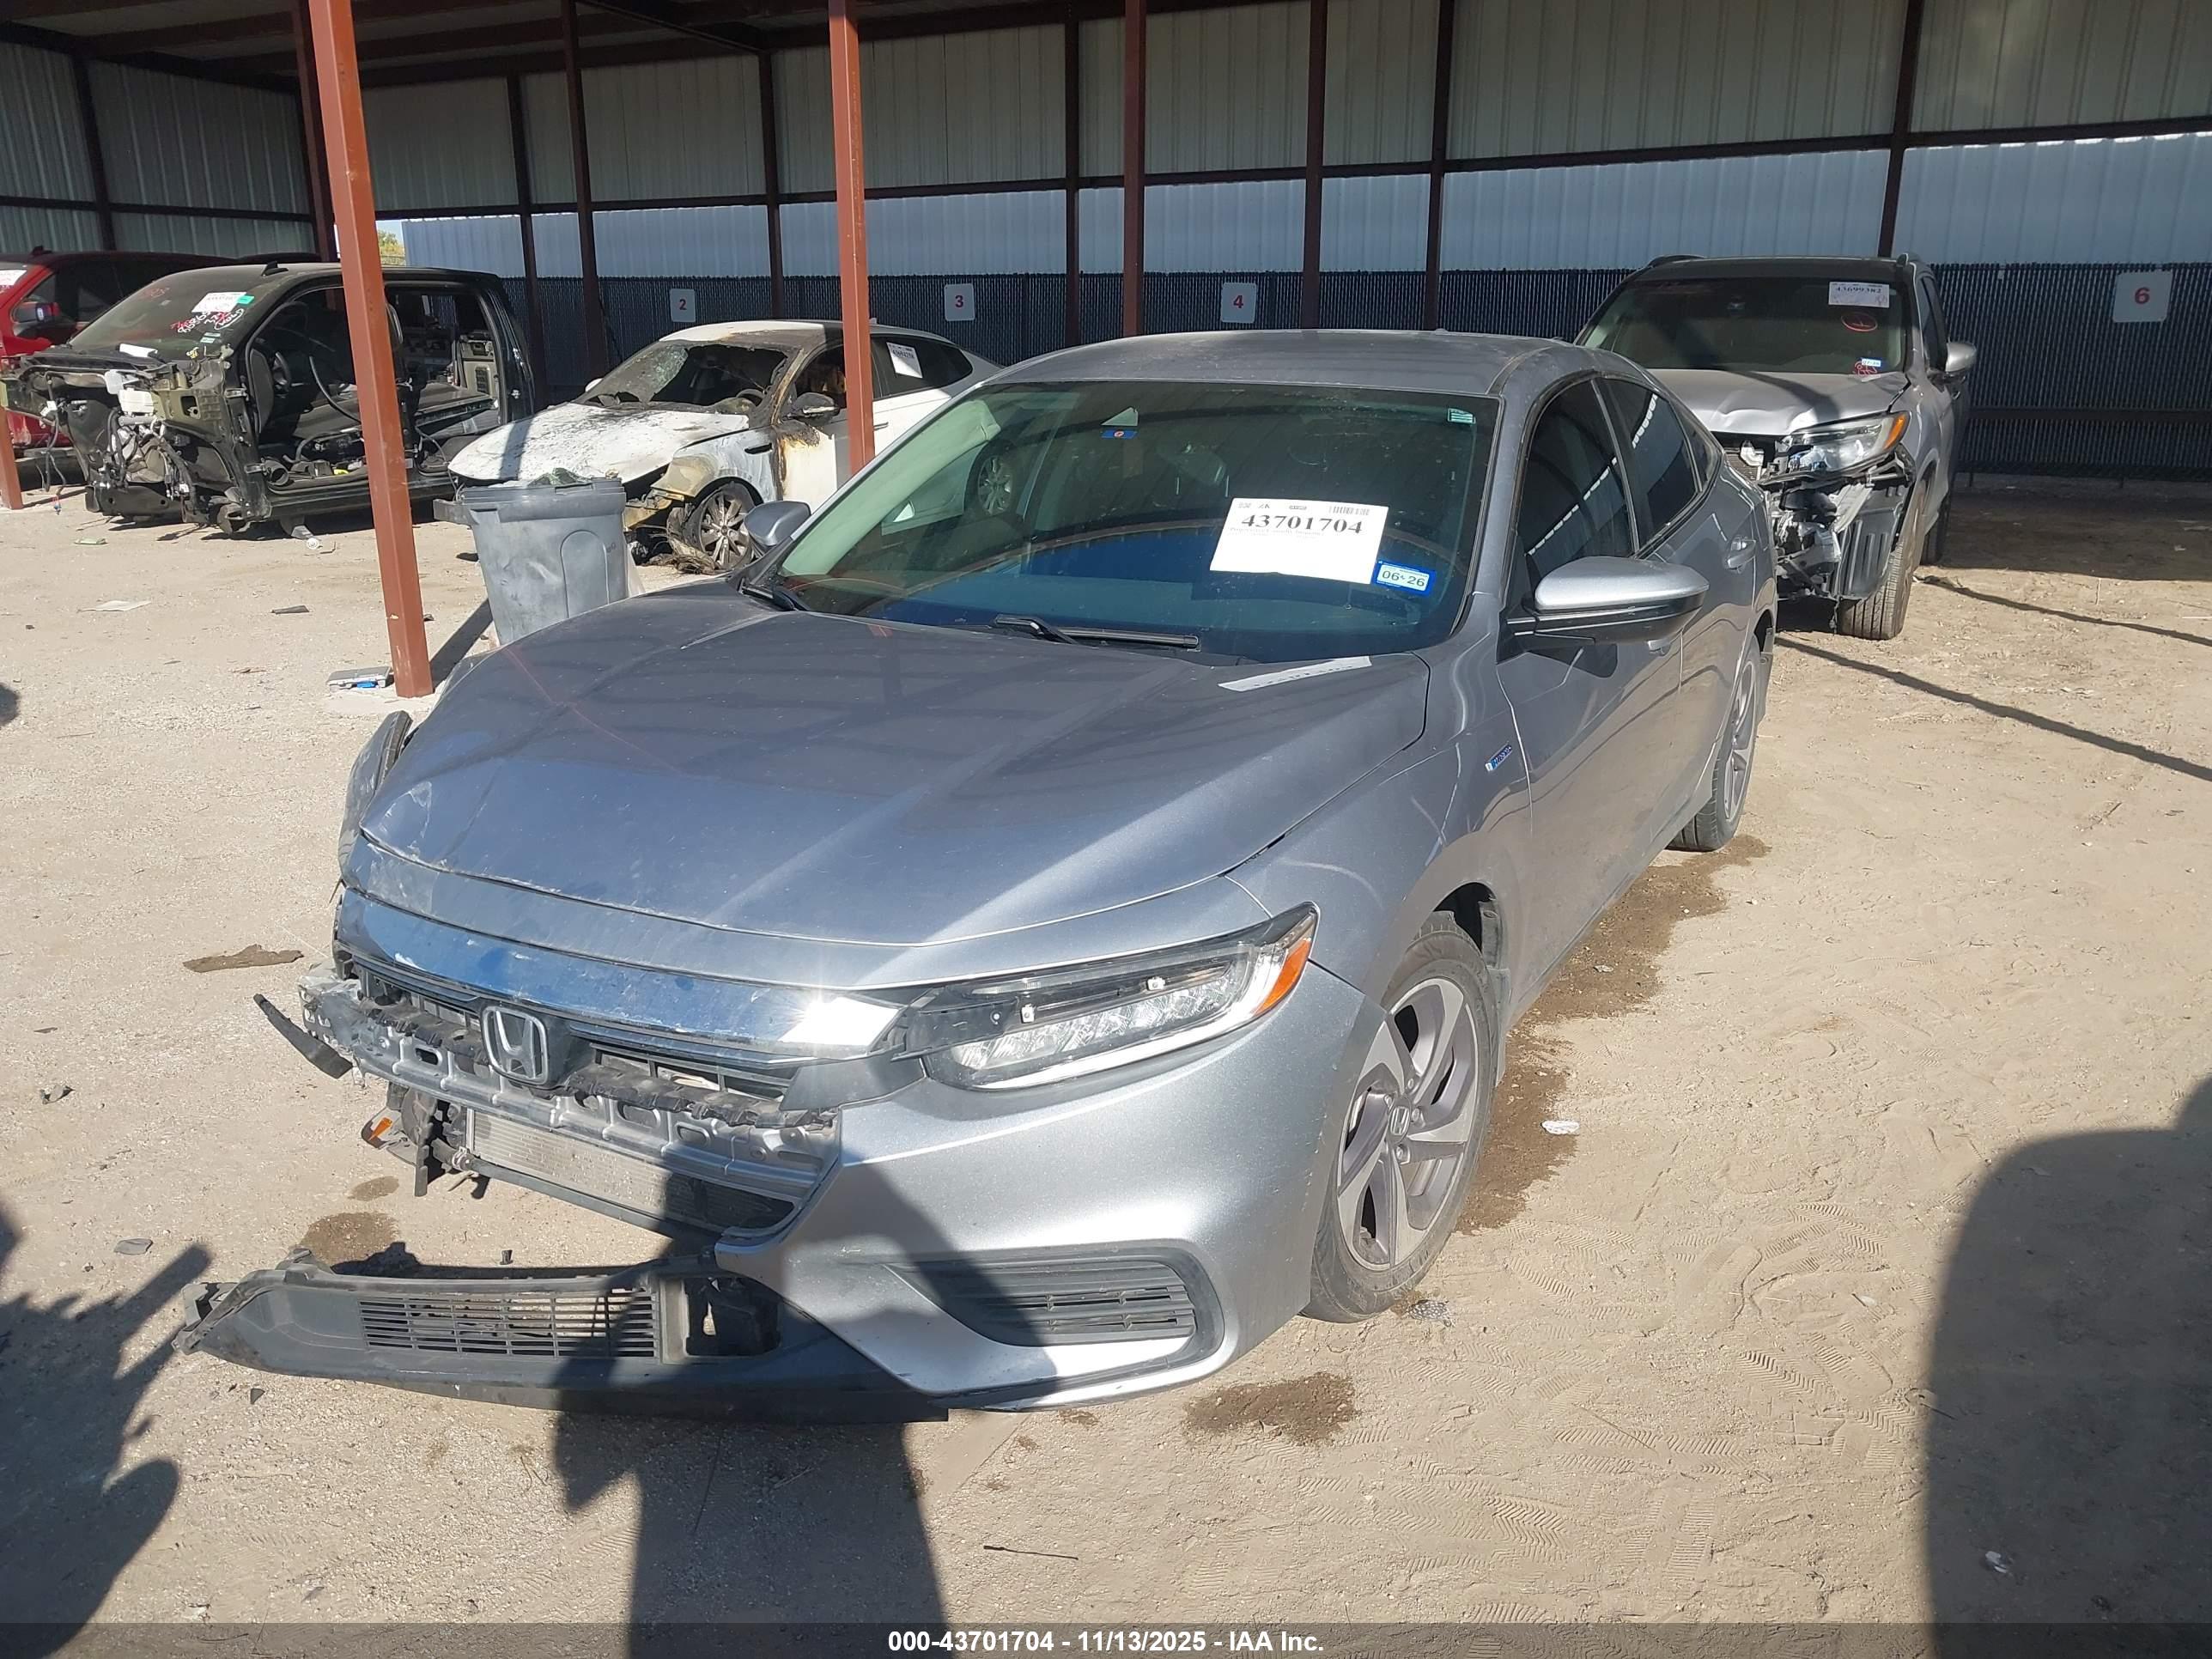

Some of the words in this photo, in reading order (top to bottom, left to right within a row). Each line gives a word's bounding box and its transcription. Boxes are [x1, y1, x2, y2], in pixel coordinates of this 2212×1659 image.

[955, 295, 963, 307] 3
[1233, 295, 1243, 309] 4
[2135, 287, 2150, 304] 6
[679, 298, 687, 311] 2
[1242, 514, 1362, 534] 43701704
